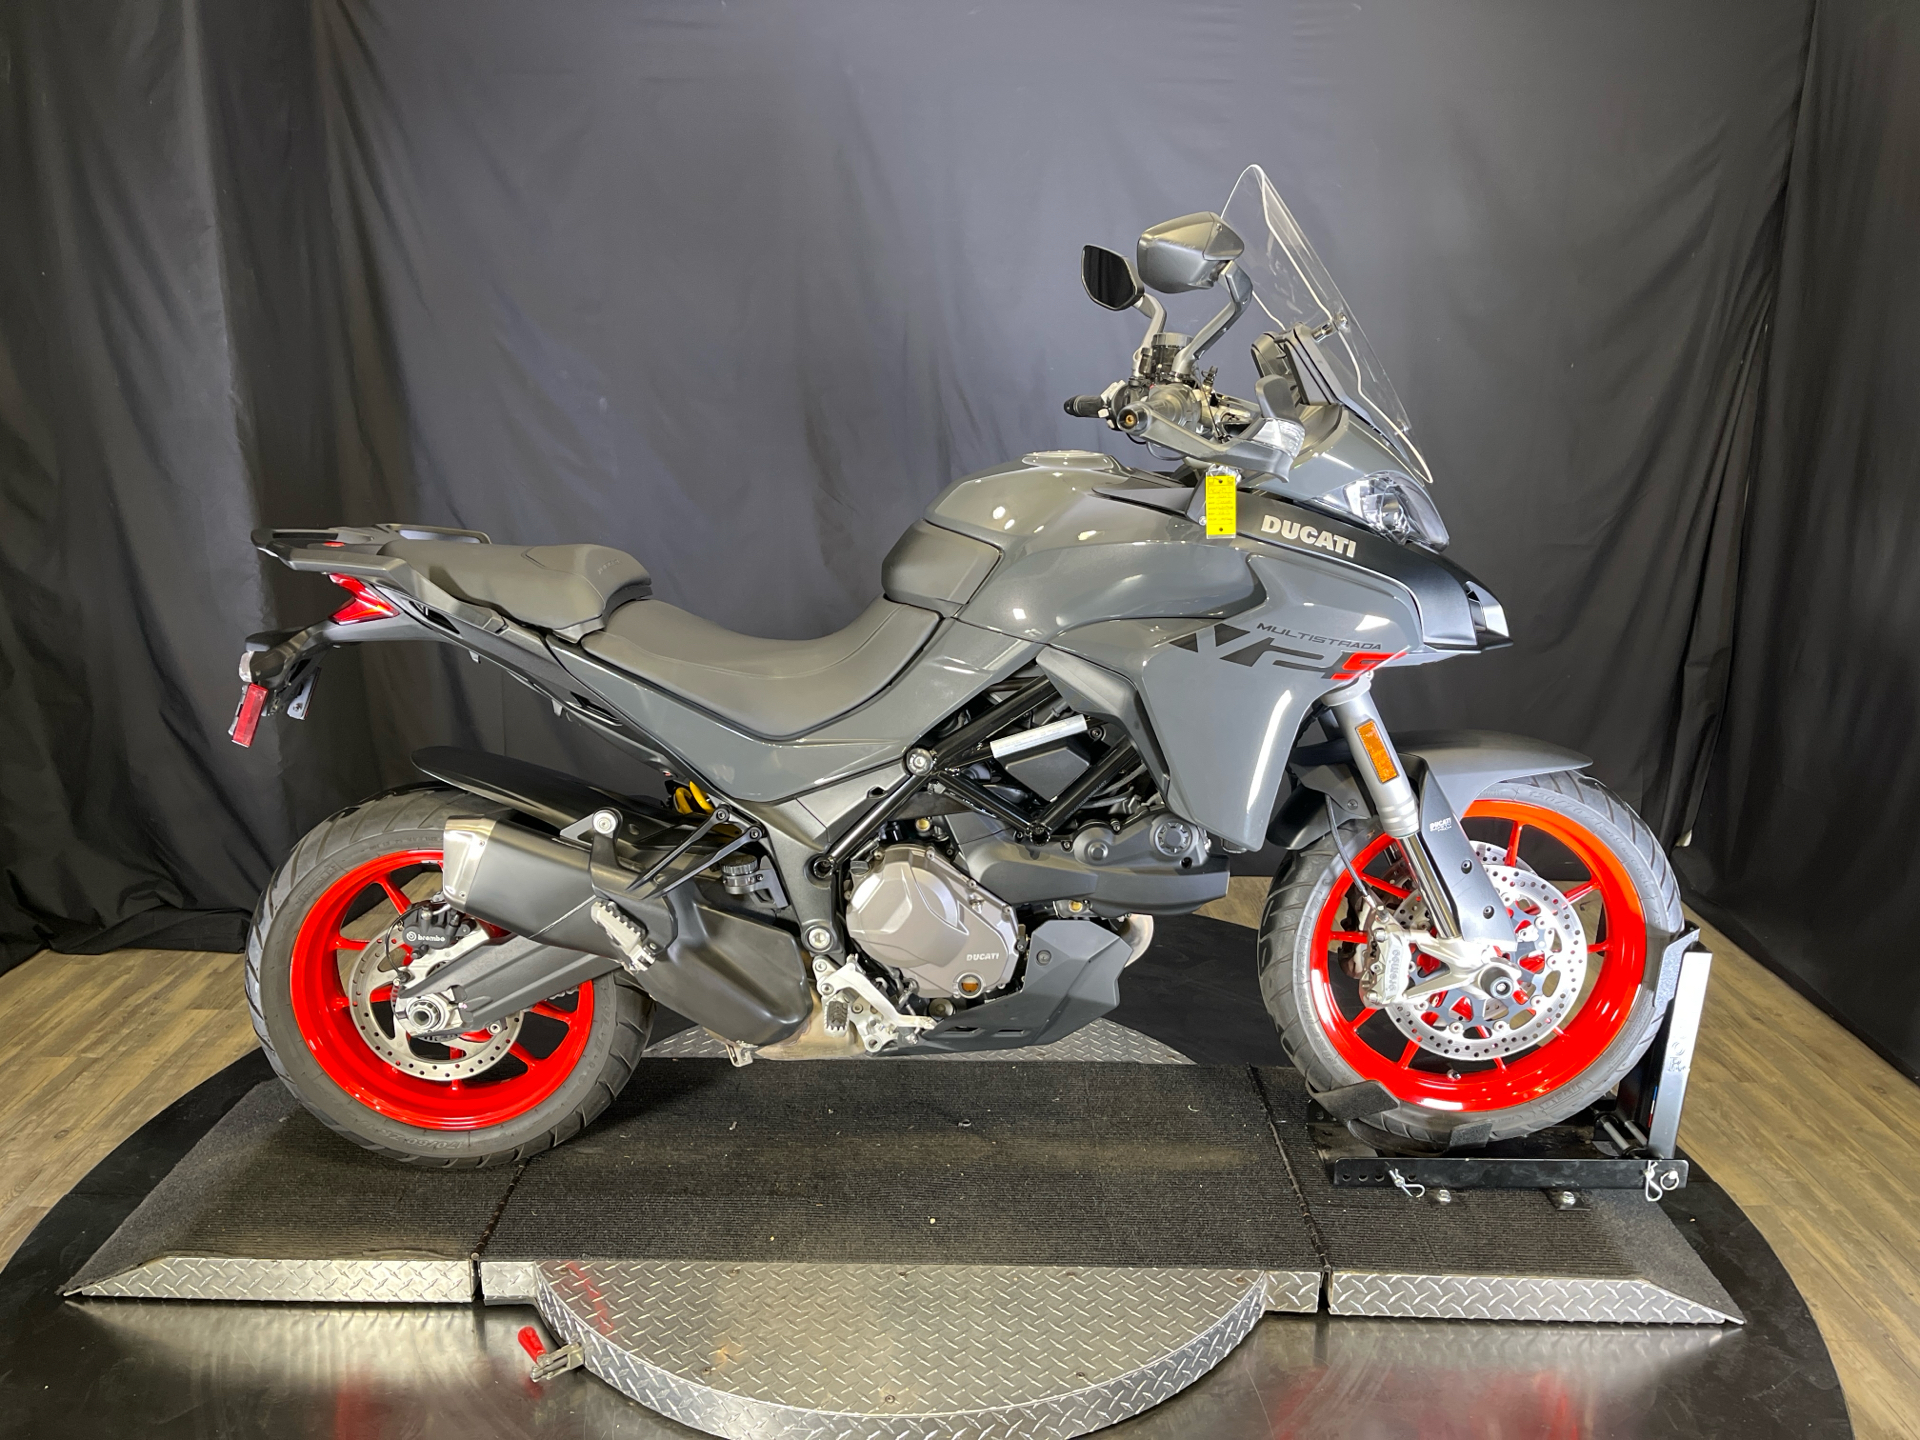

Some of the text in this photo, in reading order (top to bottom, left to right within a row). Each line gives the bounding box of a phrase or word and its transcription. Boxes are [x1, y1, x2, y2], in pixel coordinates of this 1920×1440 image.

[1261, 514, 1356, 558] DUCATI
[1256, 622, 1382, 651] MULTISTRADA
[417, 933, 446, 943] brembo
[966, 952, 1000, 962] DUCATI
[1384, 948, 1400, 992] brembo
